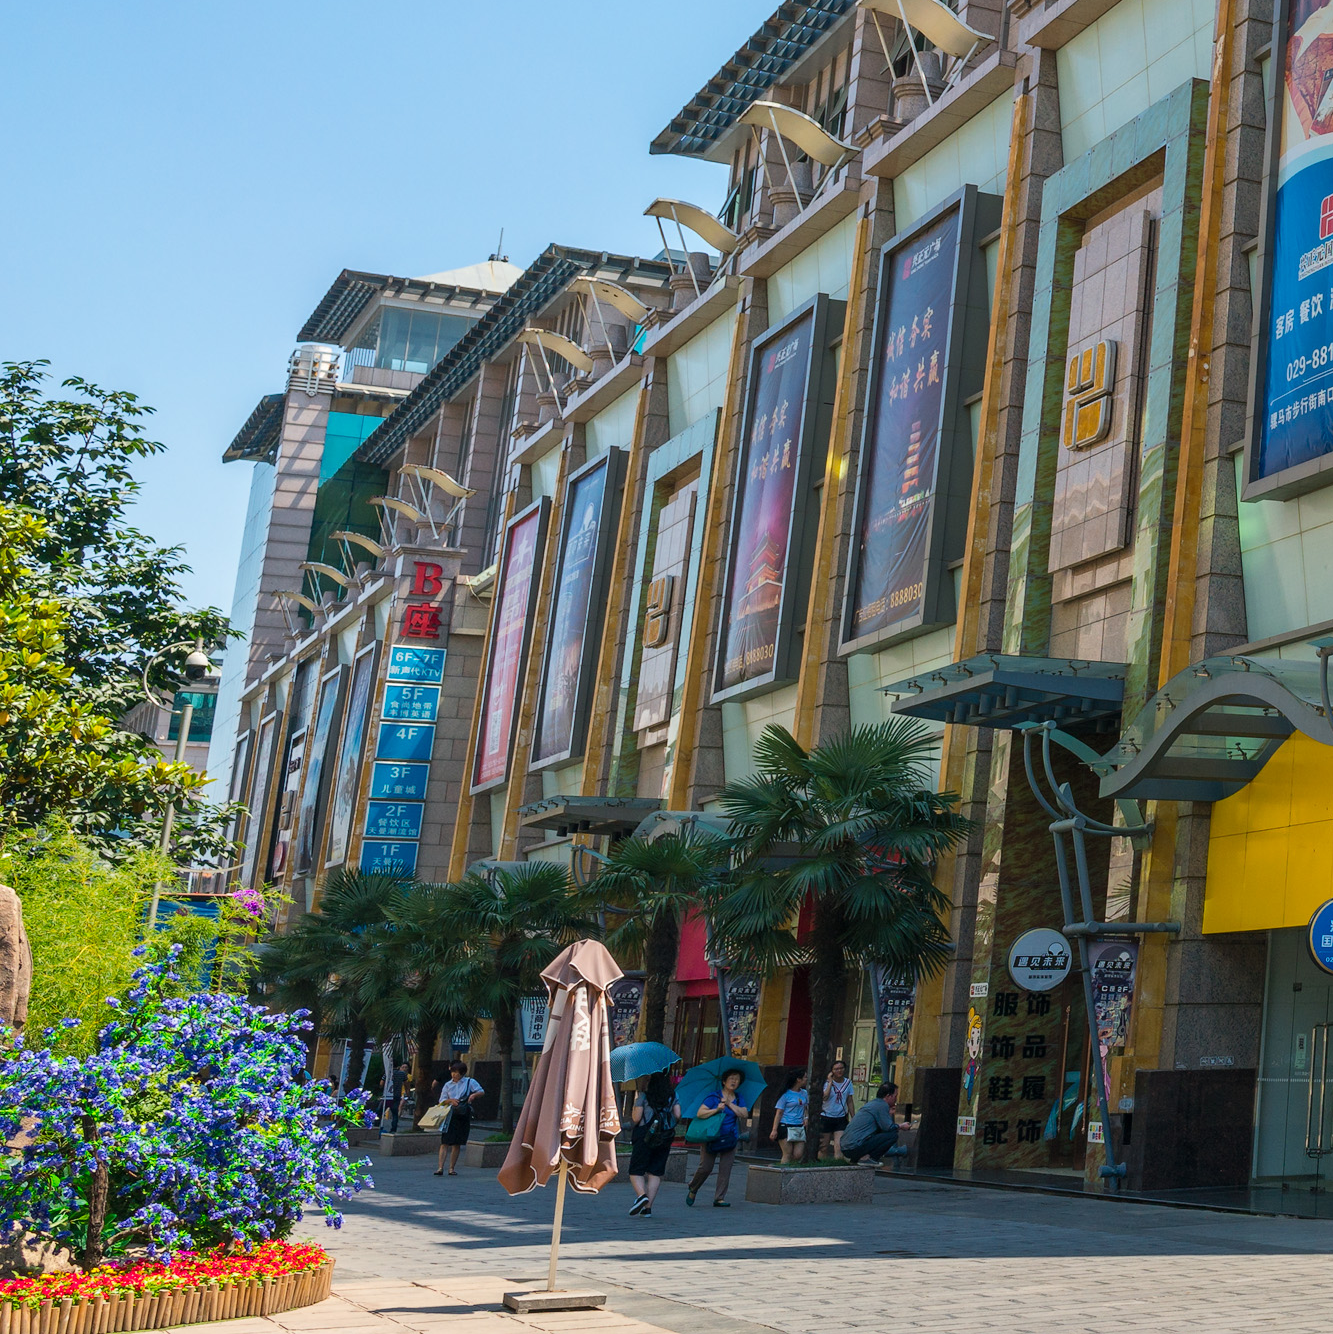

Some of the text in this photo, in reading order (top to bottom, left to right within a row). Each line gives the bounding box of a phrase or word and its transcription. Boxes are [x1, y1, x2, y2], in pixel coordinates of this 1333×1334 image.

[1275, 308, 1295, 340] 客房
[1300, 293, 1323, 325] 餐饮
[400, 561, 443, 639] B座
[402, 688, 425, 700] 5F
[396, 728, 419, 740] 4F
[390, 767, 411, 779] 3F
[381, 784, 417, 795] 儿童城
[385, 805, 407, 817] 2F
[378, 818, 411, 828] 餐饮区
[381, 844, 401, 856] 1F
[1017, 956, 1066, 967] 遇见未来
[992, 992, 1051, 1017] 服饰
[532, 1006, 545, 1041] 招商中心
[989, 1034, 1046, 1060] 饰品
[987, 1075, 1046, 1102] 鞋履
[982, 1119, 1042, 1145] 配饰
